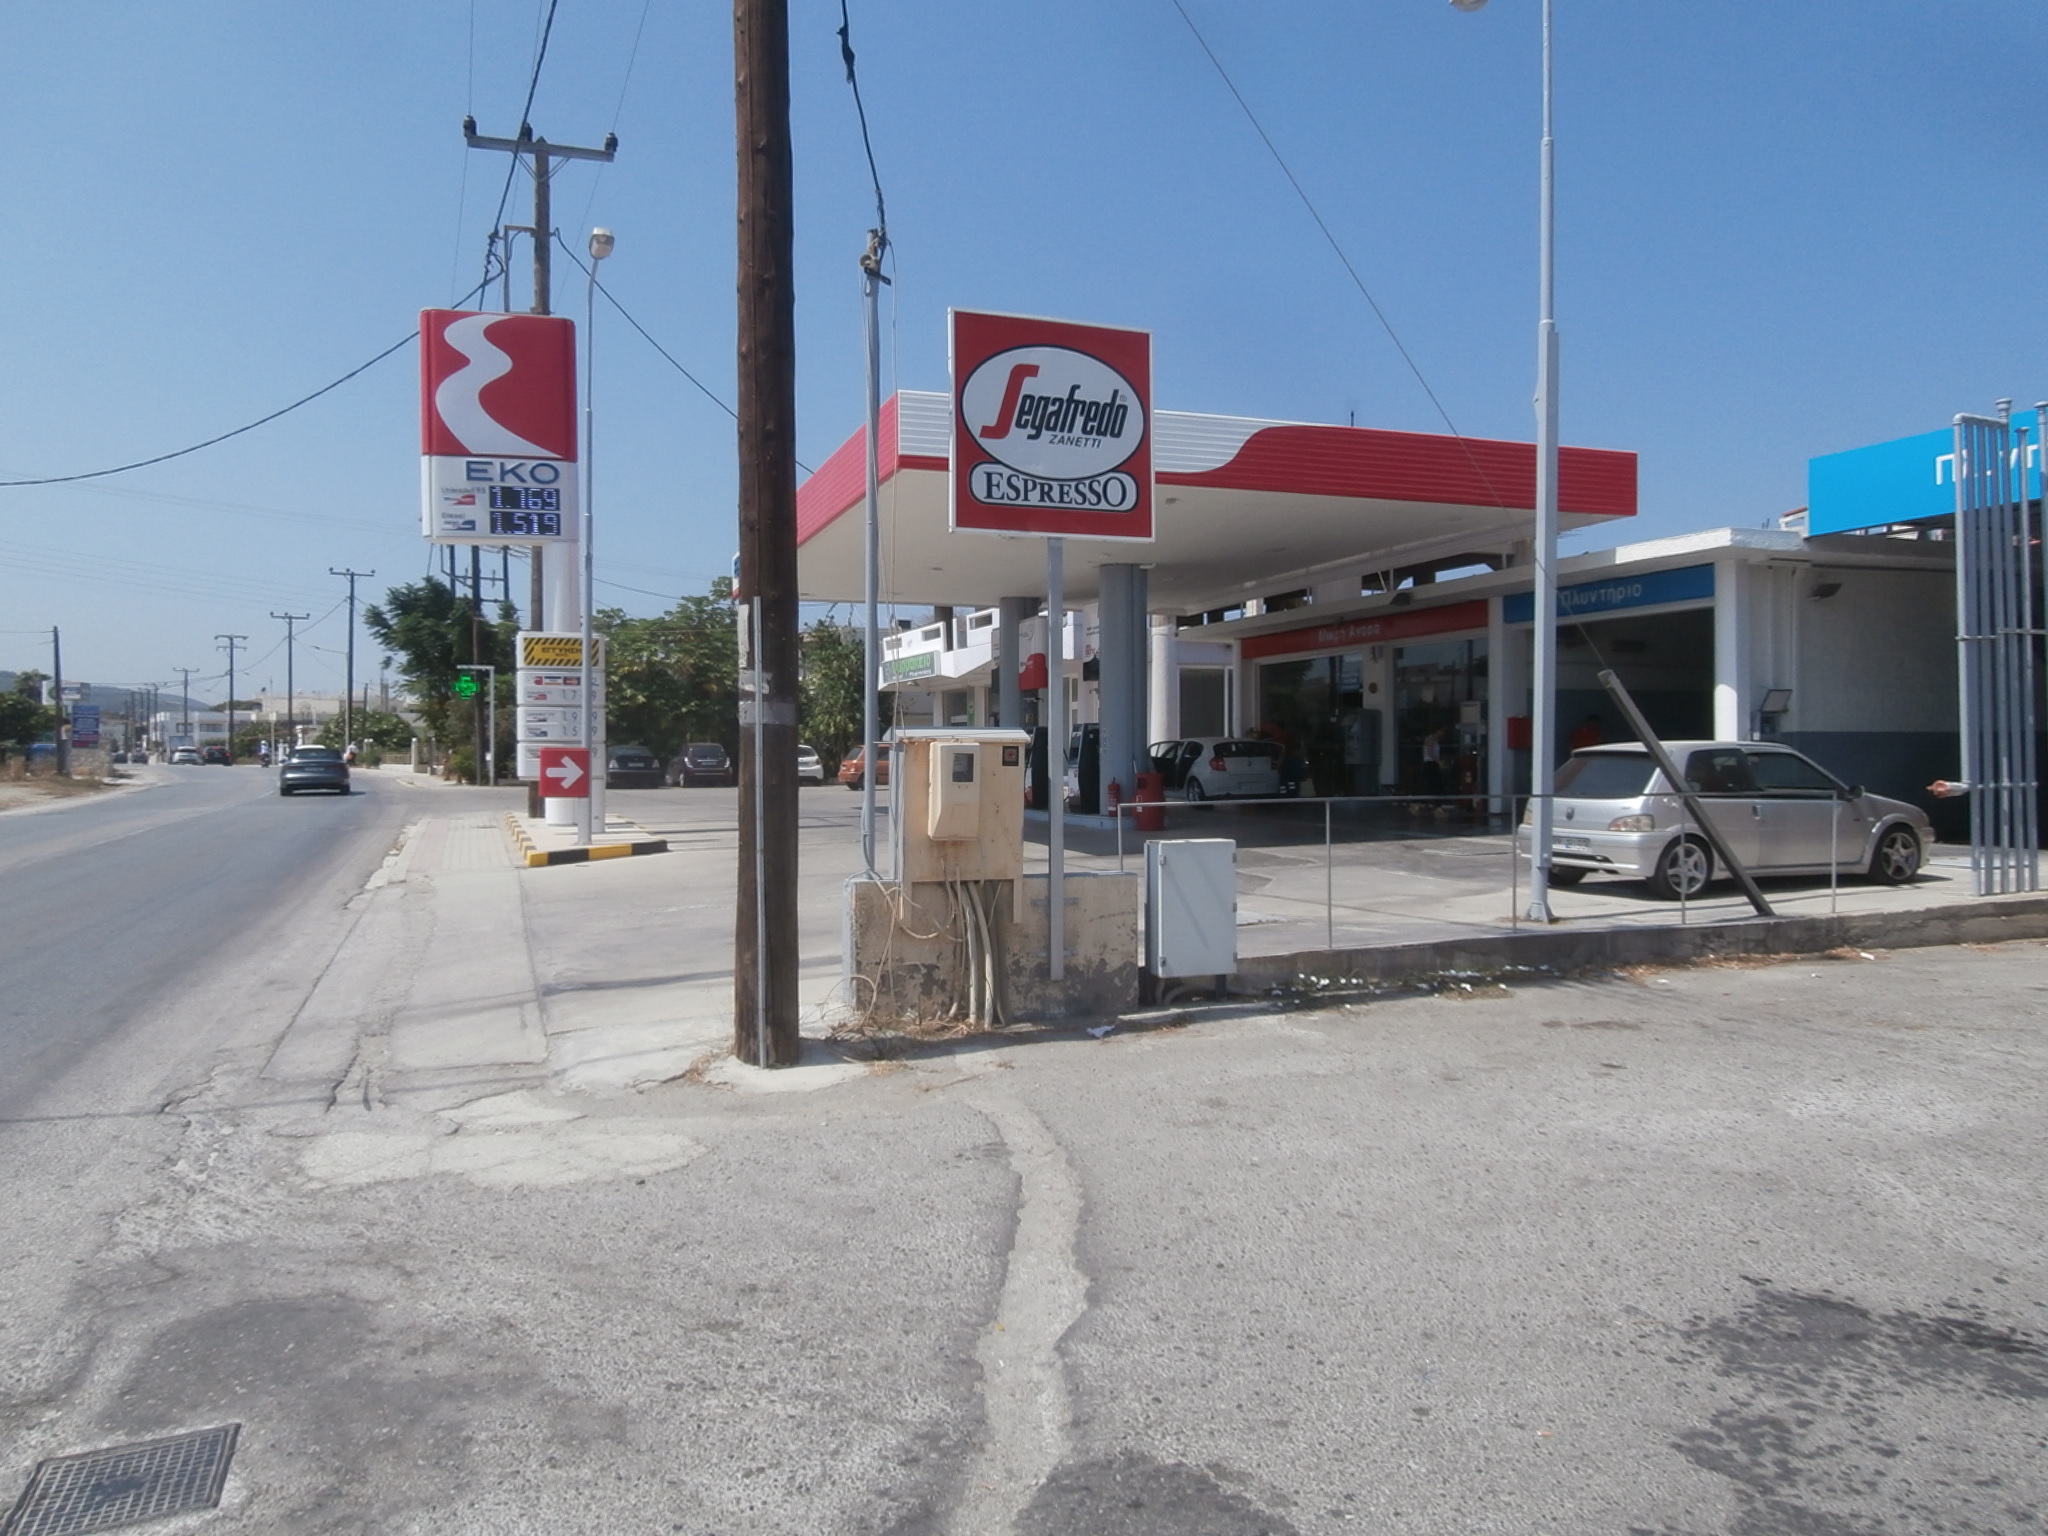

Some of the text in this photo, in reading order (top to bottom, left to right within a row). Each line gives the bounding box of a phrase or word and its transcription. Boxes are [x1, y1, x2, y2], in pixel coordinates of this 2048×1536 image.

[980, 364, 1128, 440] Segafredo
[1049, 435, 1102, 448] ZANETTI
[466, 461, 560, 484] EKO
[984, 471, 1127, 507] ESPRESSO
